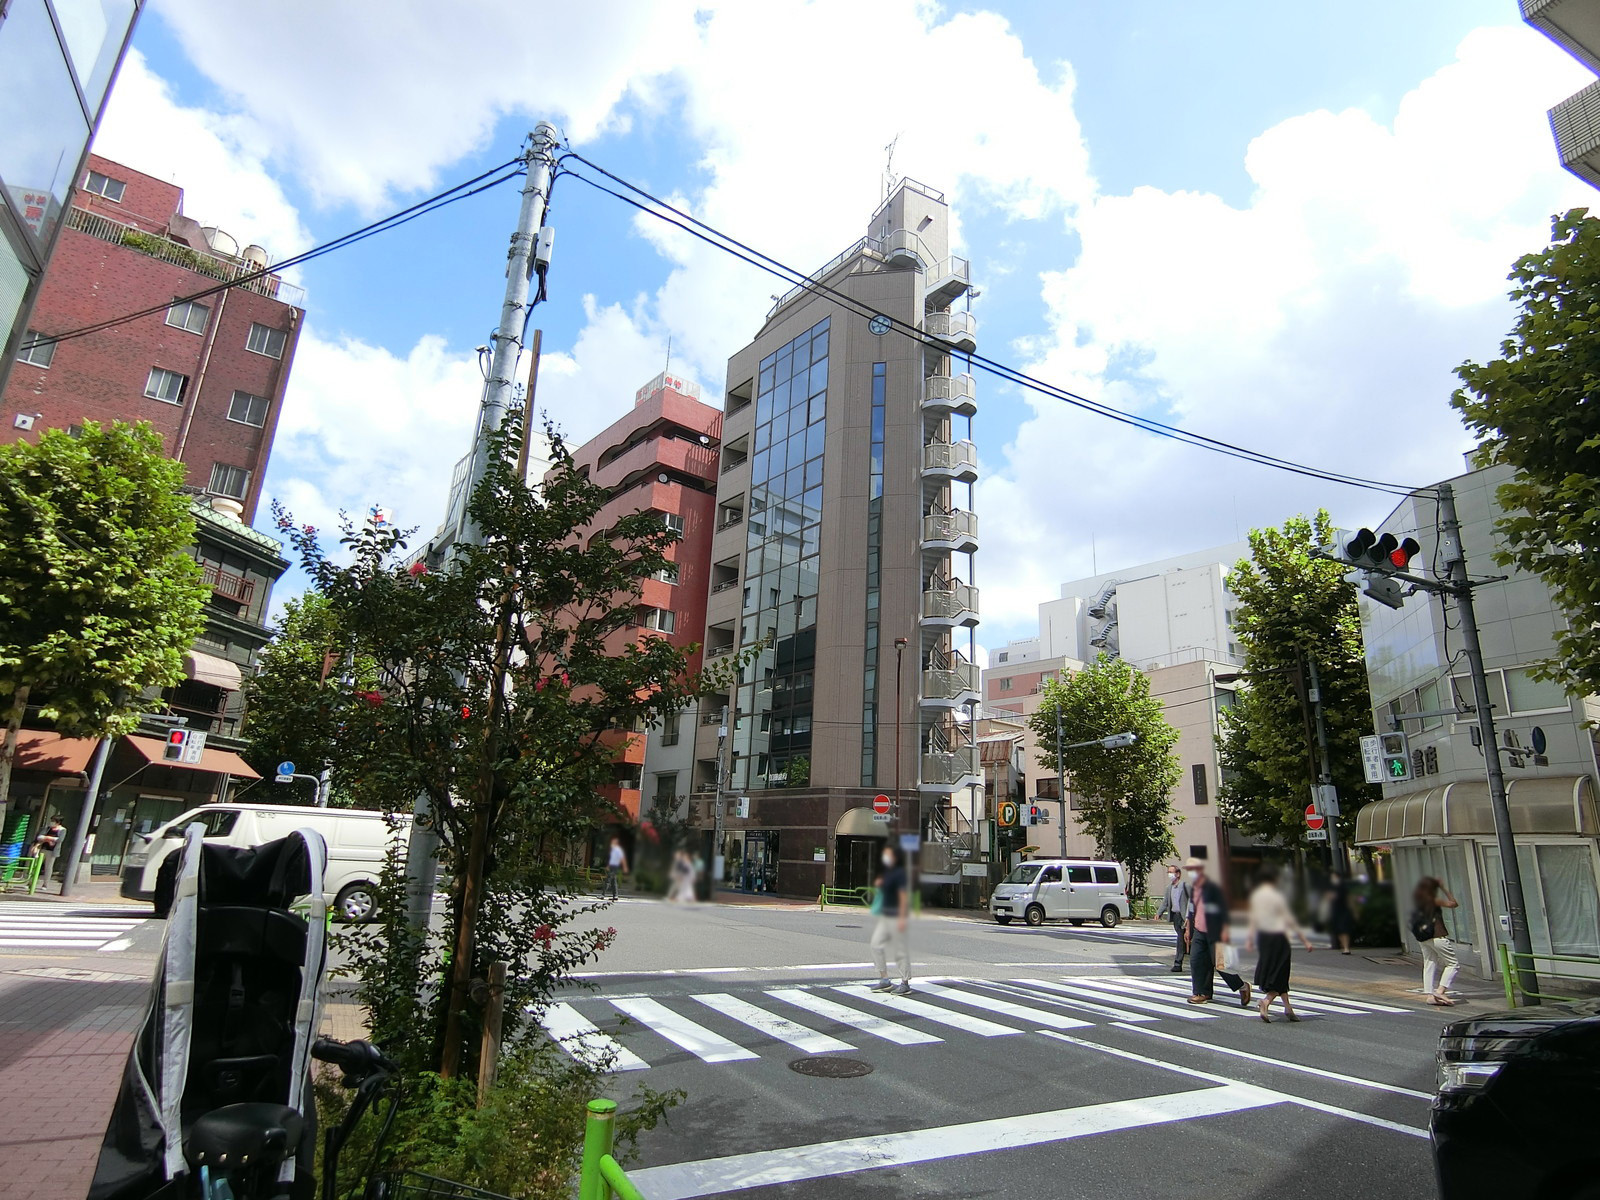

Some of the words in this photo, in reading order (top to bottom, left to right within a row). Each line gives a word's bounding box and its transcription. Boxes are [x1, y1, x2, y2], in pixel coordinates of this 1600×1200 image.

[1363, 740, 1371, 763] 自転車
[1370, 739, 1379, 763] 歩行者
[1412, 745, 1439, 777] 書店
[1005, 806, 1013, 822] P
